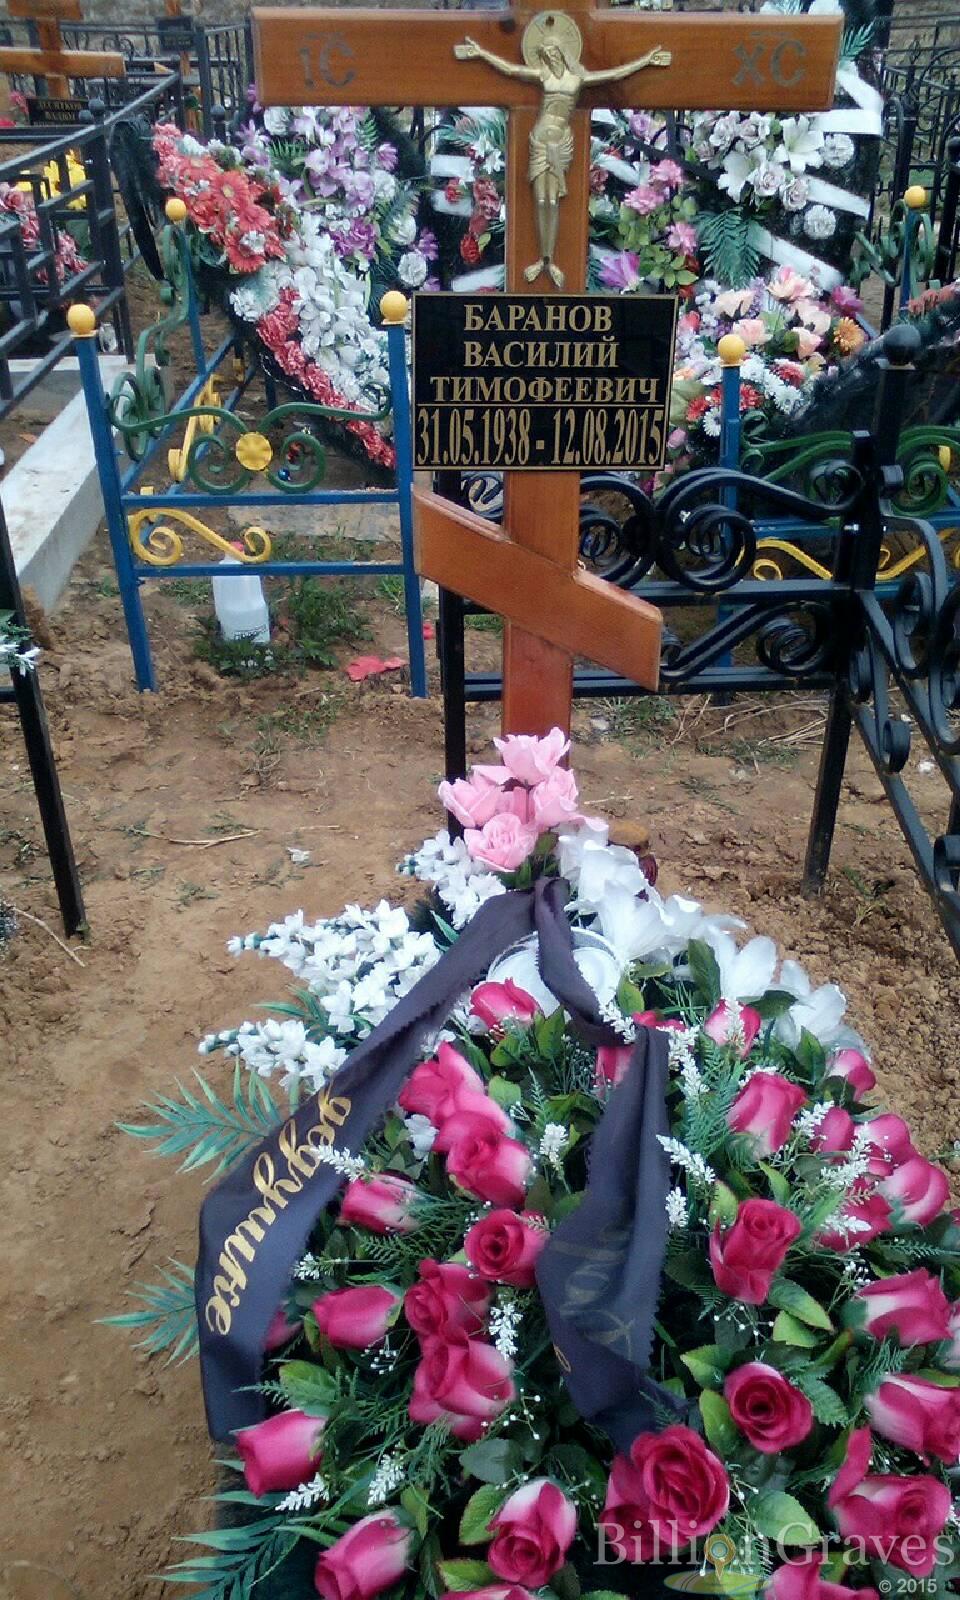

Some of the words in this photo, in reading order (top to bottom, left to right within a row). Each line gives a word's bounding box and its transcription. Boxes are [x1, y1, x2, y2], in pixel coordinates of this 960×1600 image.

[463, 304, 612, 332] БАРАНОВ
[463, 335, 620, 368] ВАСИЛИЙ
[430, 376, 660, 403] ТИМОФЕЕВИЧ
[417, 408, 531, 465] 31.05.1938
[550, 408, 664, 465] 12.08.2015
[205, 1081, 351, 1335] дедушке
